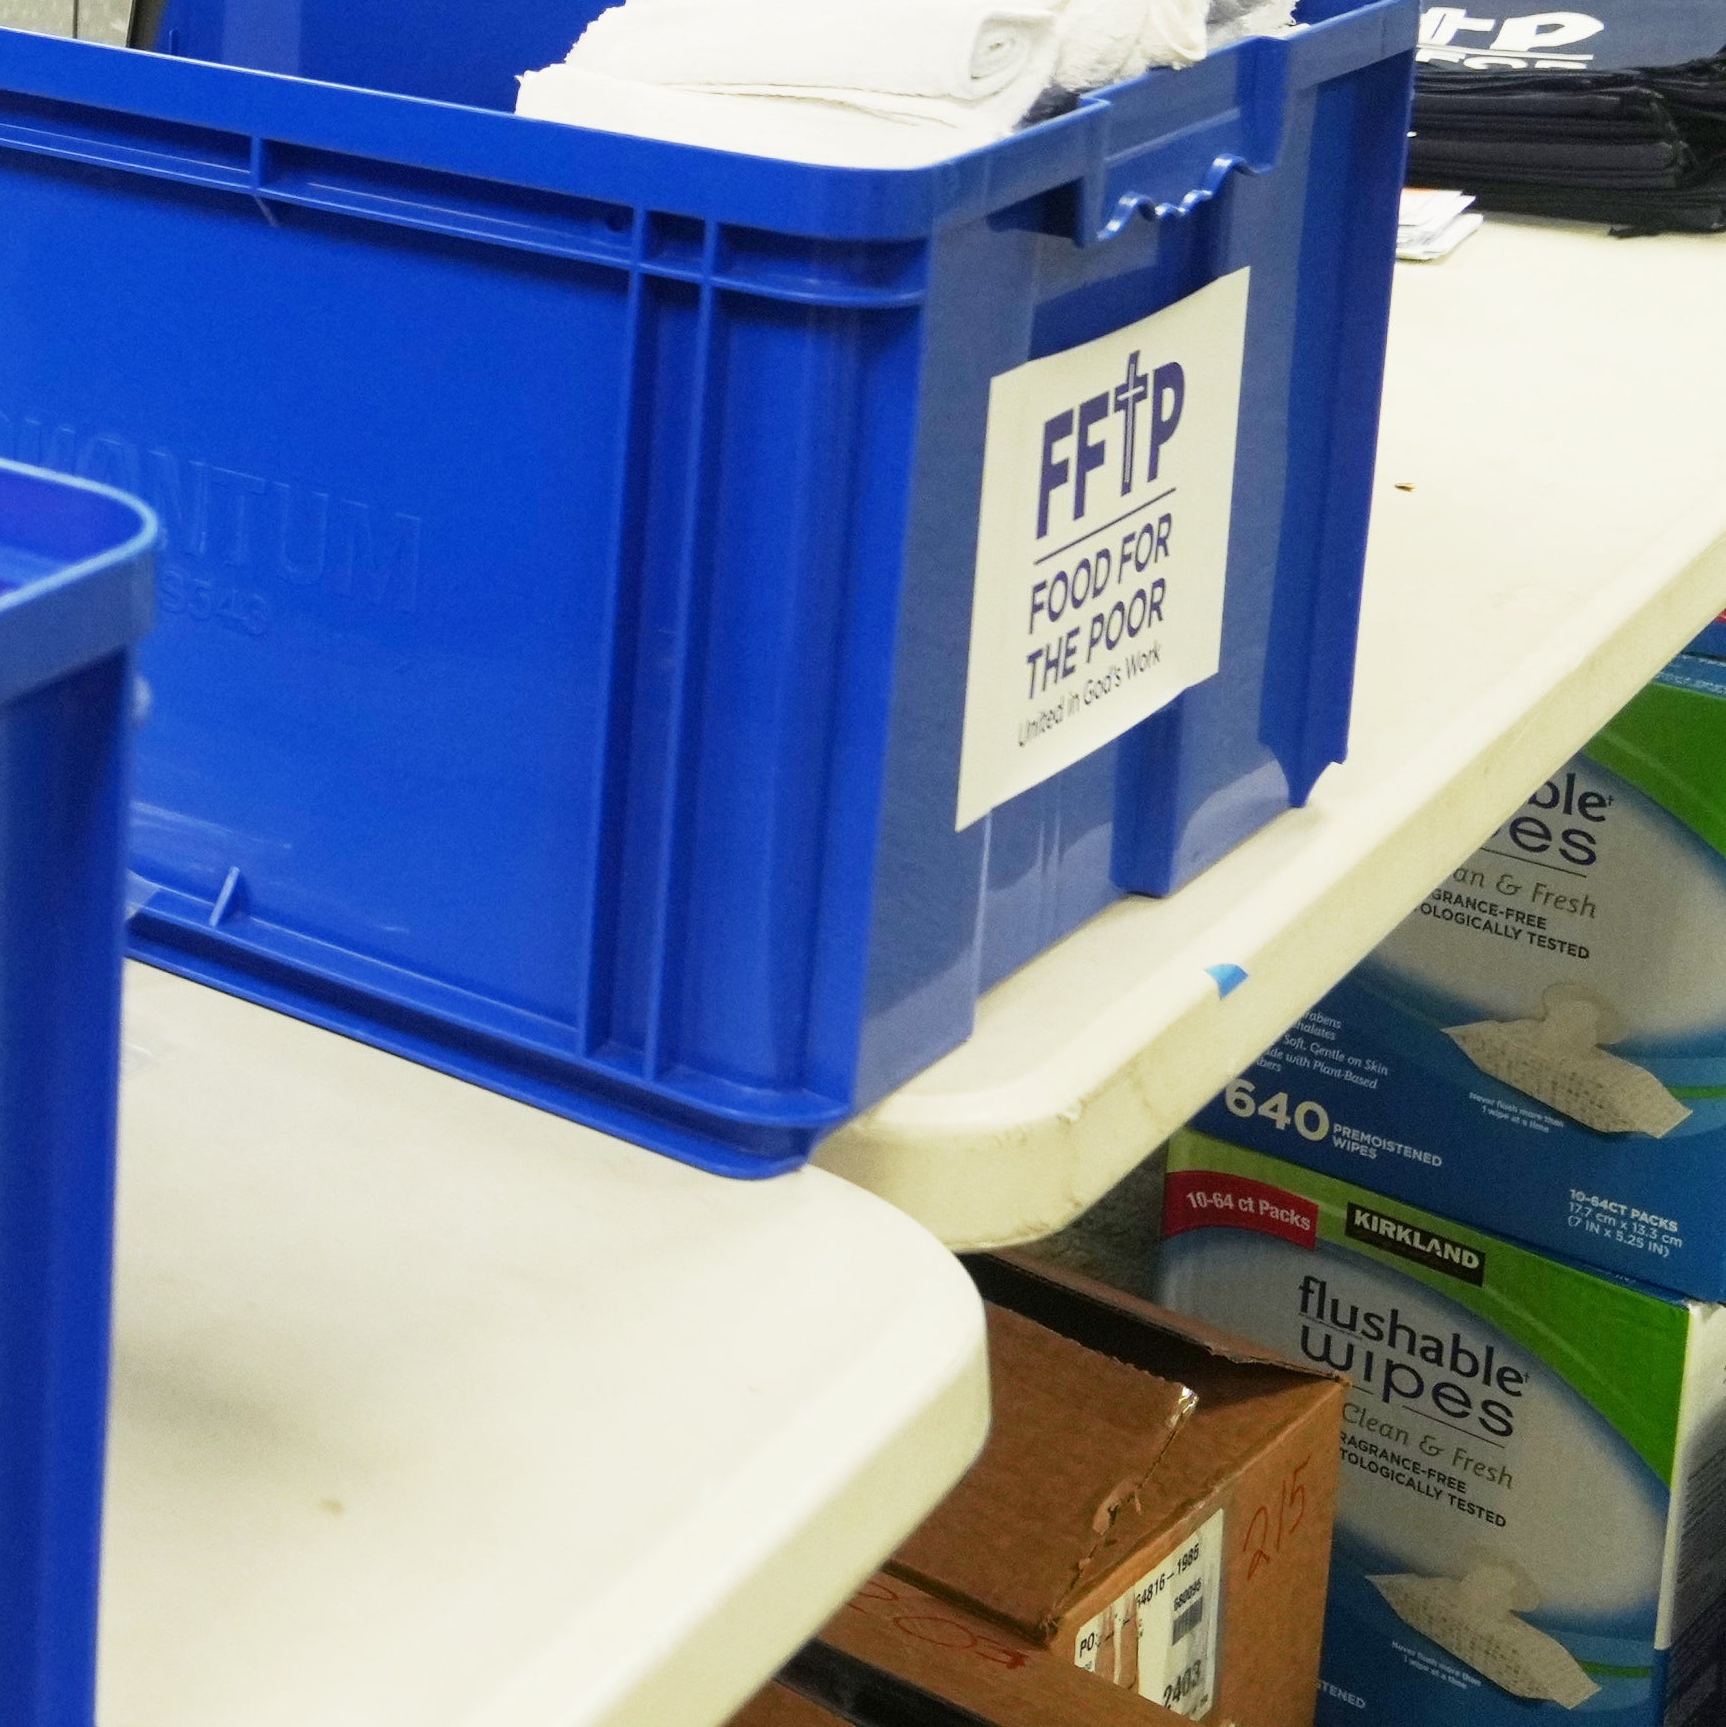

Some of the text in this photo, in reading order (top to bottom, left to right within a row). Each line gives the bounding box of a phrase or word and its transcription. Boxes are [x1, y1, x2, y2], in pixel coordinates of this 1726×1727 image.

[1028, 513, 1172, 634] FOOD FOR
[1027, 577, 1166, 700] THE POOR
[1018, 640, 1162, 748] United in God's Work
[1429, 888, 1547, 931] GRANCE-FREE
[1531, 882, 1597, 919] Fresh
[1414, 903, 1590, 960] OLOGICALLY TESTED
[1286, 1052, 1311, 1069] with
[1312, 1060, 1379, 1090] Plant-Based
[1310, 1042, 1345, 1062] Gentle
[1347, 1056, 1362, 1069] on
[1365, 1059, 1389, 1076] Skin
[1224, 1078, 1330, 1142] 640
[1332, 1124, 1443, 1168] PREMOISTENED
[1332, 1135, 1378, 1160] WIPES
[1186, 1191, 1311, 1232] 10-64 ct Packs
[1569, 1189, 1679, 1232] 10-64CT PACKS
[1569, 1202, 1683, 1249] 17.7 cm x 13.3 cm
[1353, 1208, 1480, 1271] KIRKLAND
[1585, 1220, 1600, 1234] IN
[1603, 1229, 1612, 1238] x
[1616, 1230, 1644, 1249] 5.25
[1648, 1241, 1670, 1258] IN)
[1300, 1324, 1515, 1438] wipes
[1341, 1401, 1515, 1490] Clean & Fresh
[1447, 1492, 1507, 1528] TESTED
